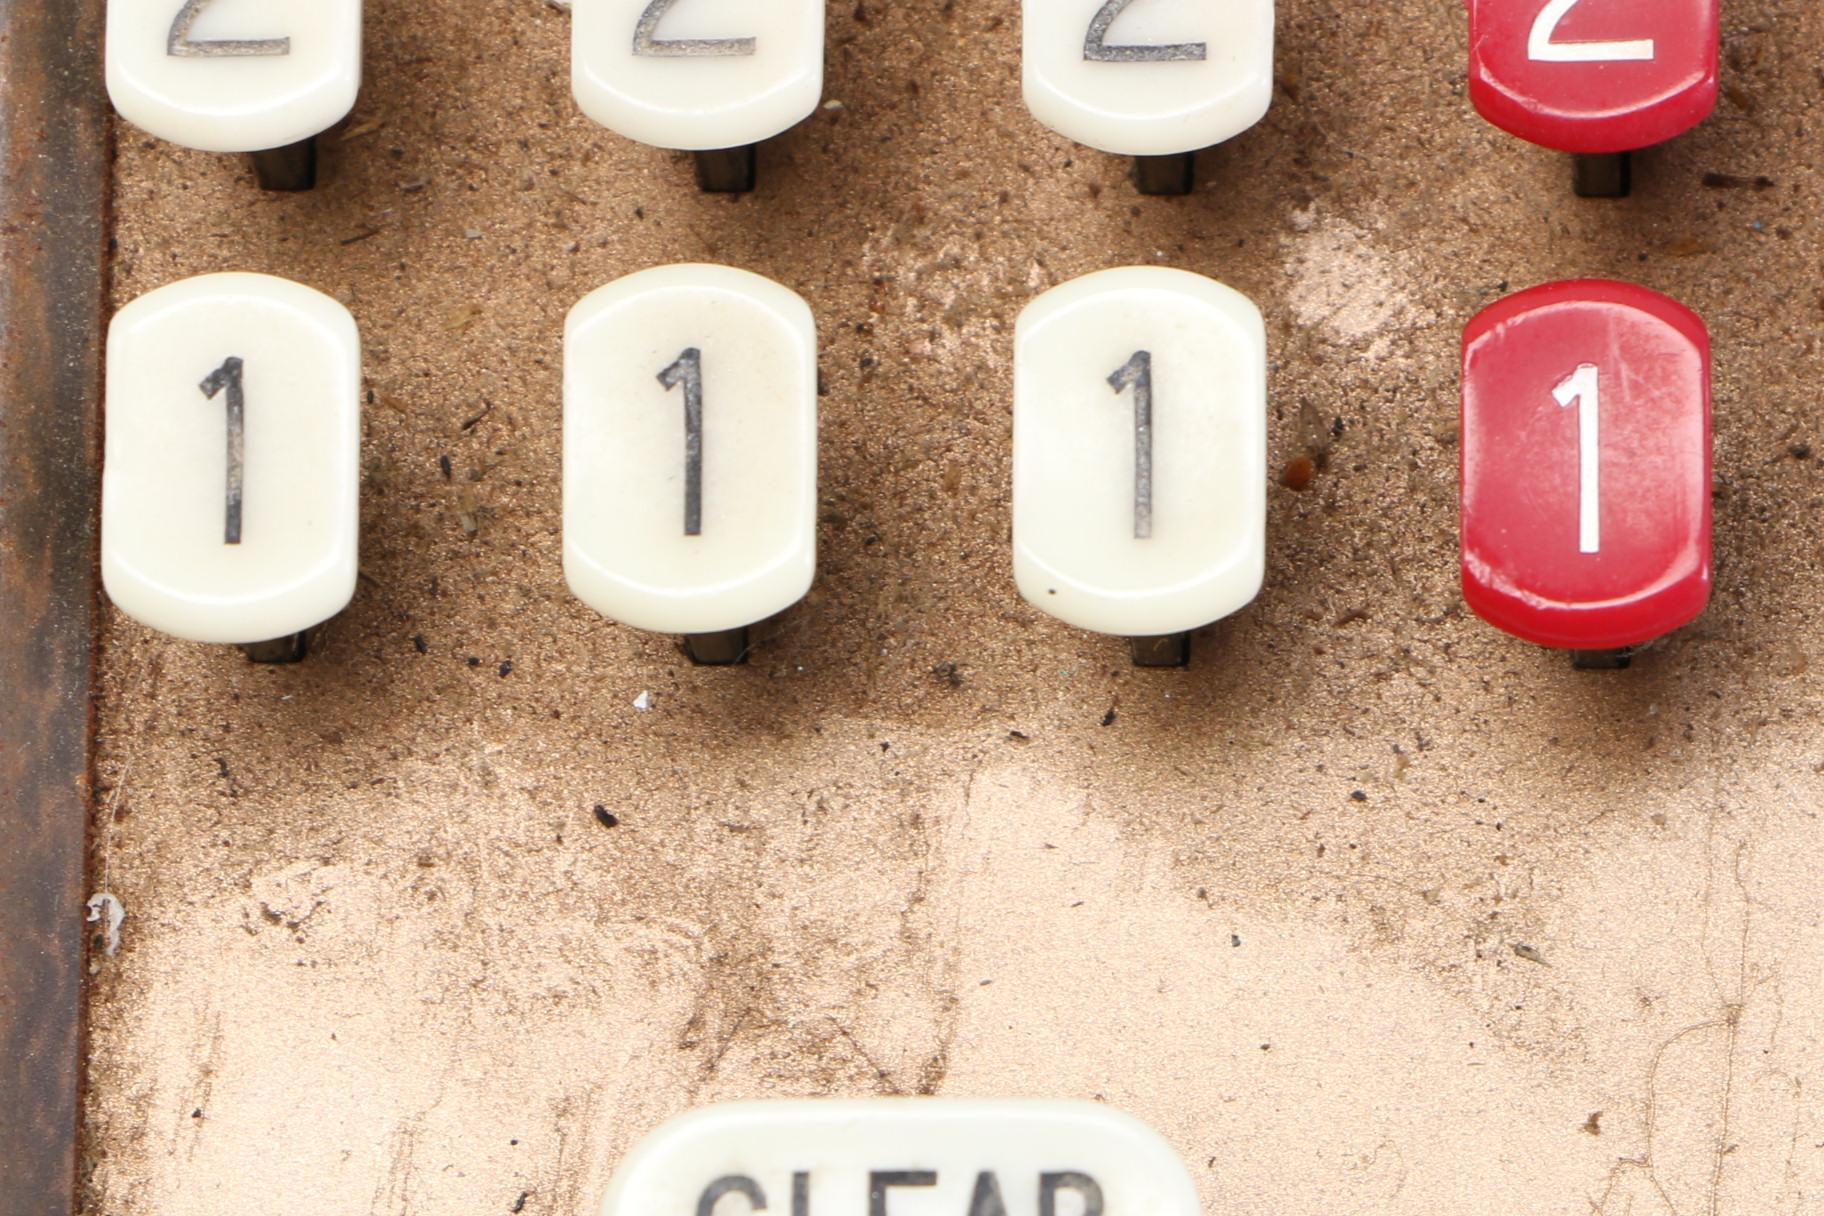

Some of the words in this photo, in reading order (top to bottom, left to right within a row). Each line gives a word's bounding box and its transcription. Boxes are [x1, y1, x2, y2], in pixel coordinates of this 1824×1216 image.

[199, 355, 244, 544] 1
[655, 347, 702, 536] 1
[1106, 349, 1152, 539] 1
[1551, 362, 1600, 553] 1
